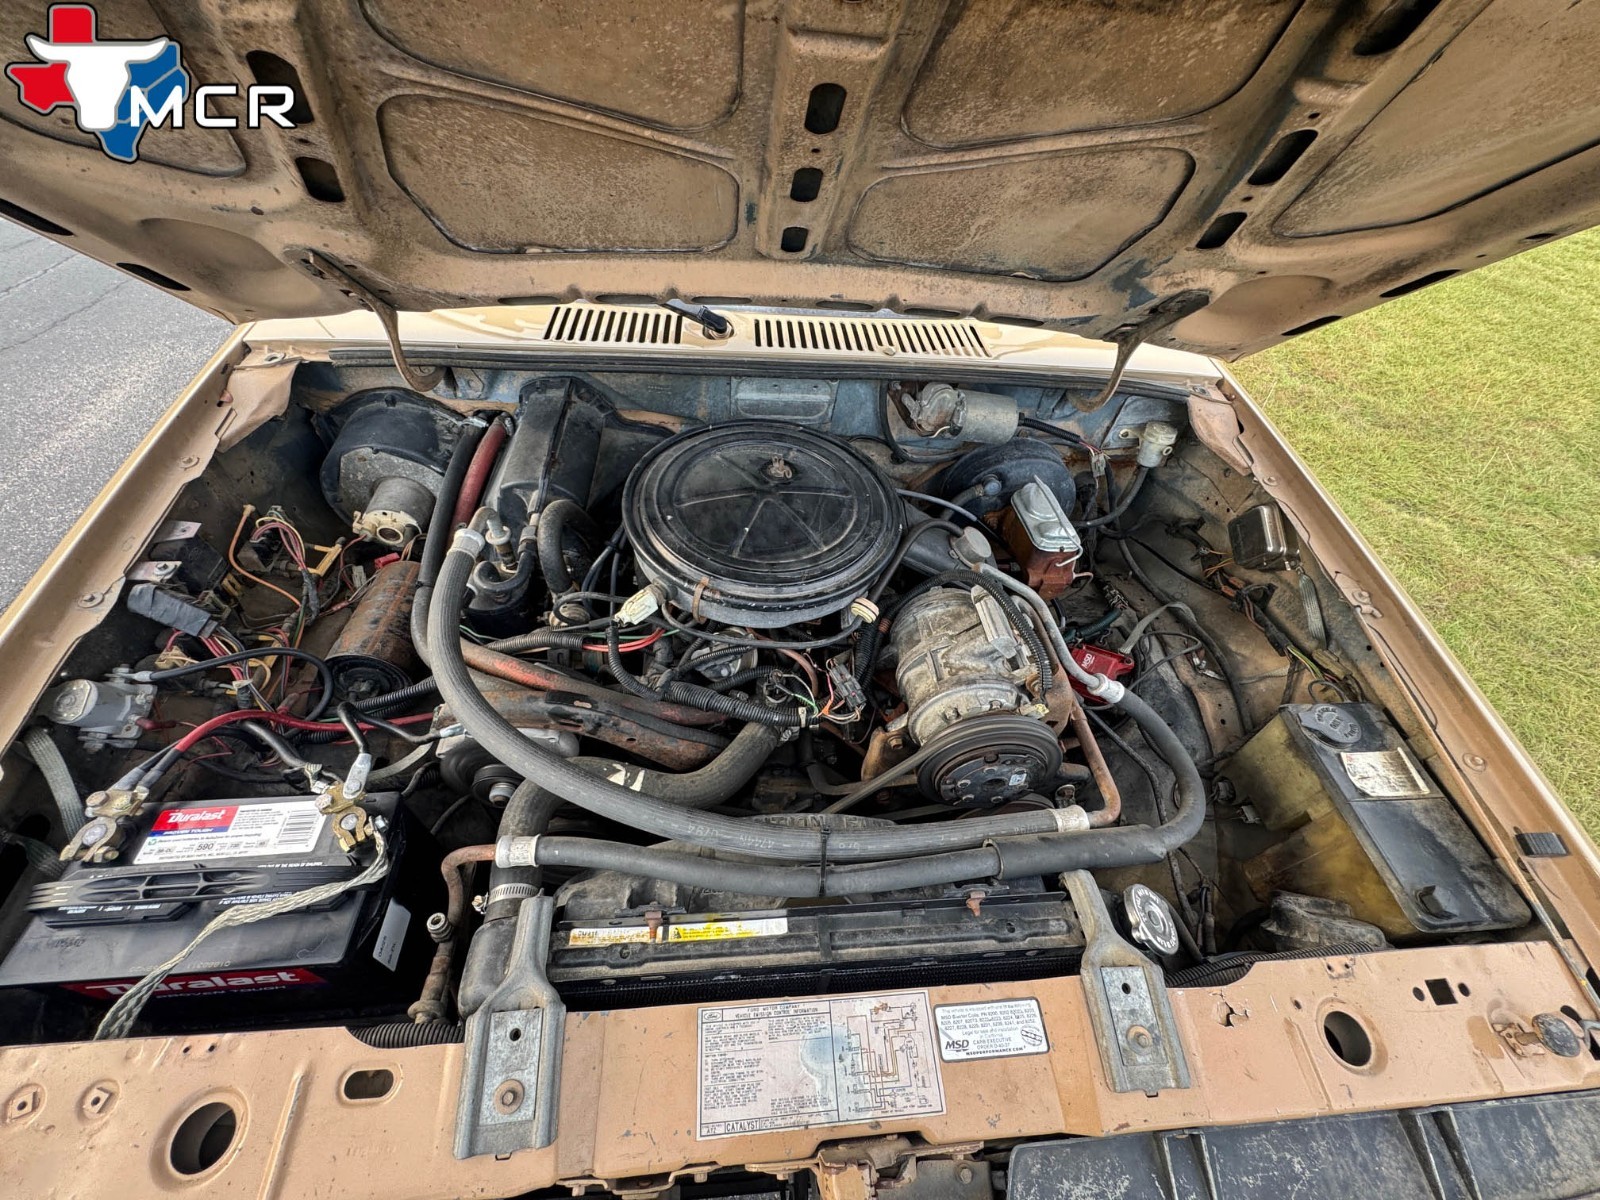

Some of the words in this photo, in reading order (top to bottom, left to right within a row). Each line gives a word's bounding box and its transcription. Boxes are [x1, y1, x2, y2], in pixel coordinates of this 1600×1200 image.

[1081, 653, 1092, 668] MSD
[168, 810, 226, 823] Duralast
[156, 990, 226, 998] PROVEN
[230, 985, 287, 993] TOUGH
[945, 1040, 969, 1050] MSD
[726, 1120, 758, 1132] CATALYST
